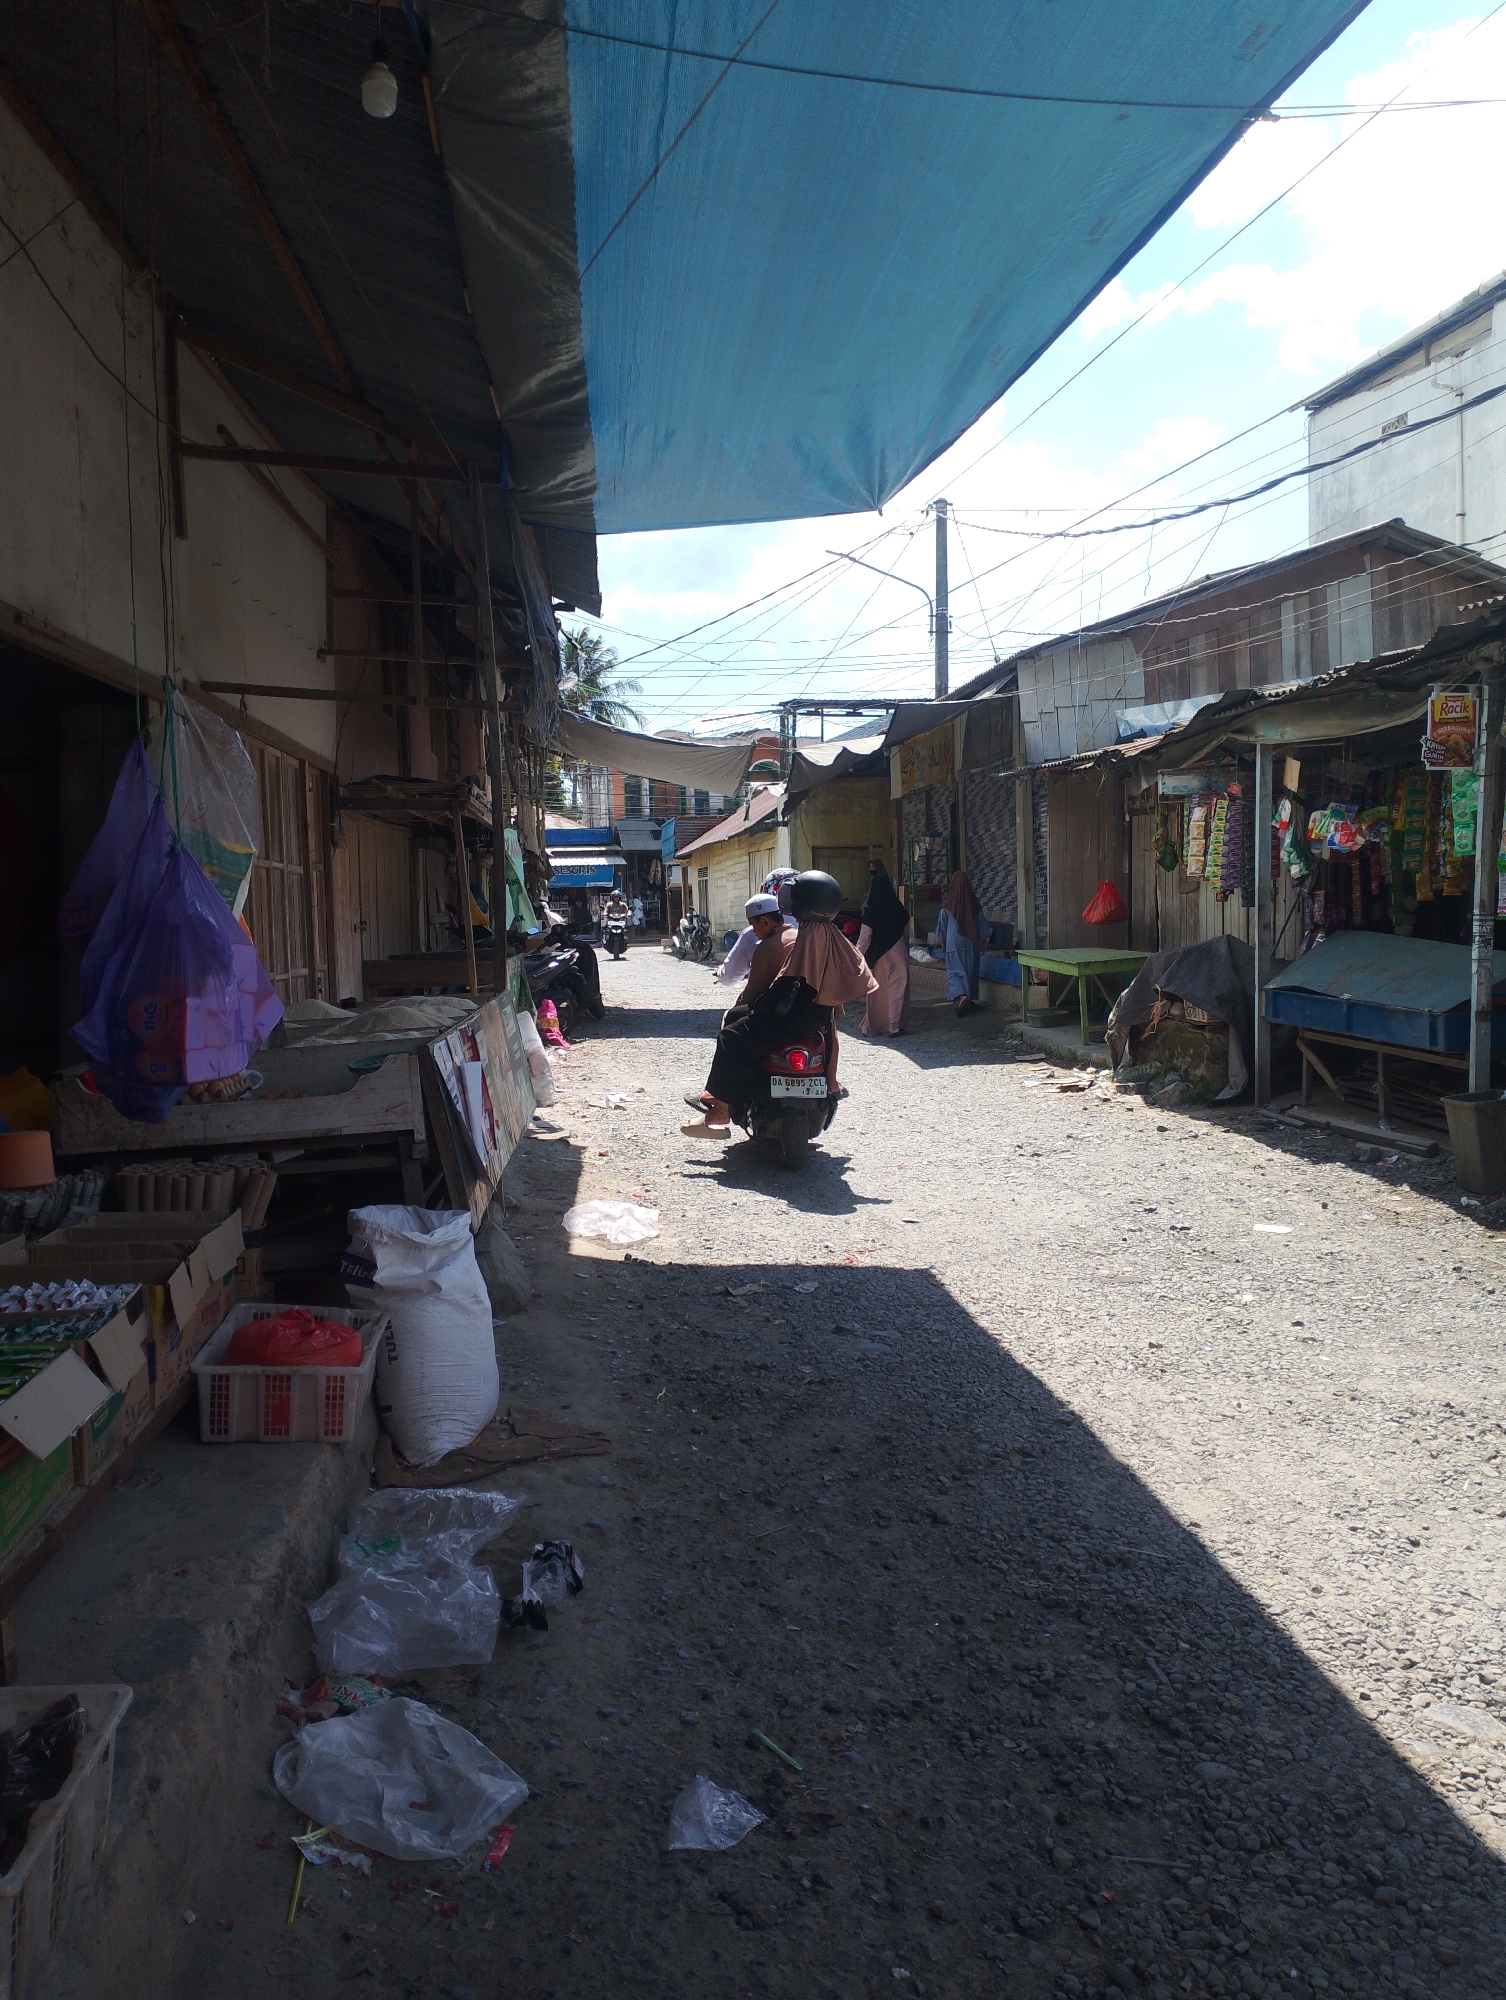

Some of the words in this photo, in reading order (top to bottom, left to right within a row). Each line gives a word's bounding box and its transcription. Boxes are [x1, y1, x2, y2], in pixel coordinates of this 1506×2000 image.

[1440, 702, 1470, 716] Racik
[772, 1077, 782, 1087] DA
[808, 1079, 825, 1088] ZCL
